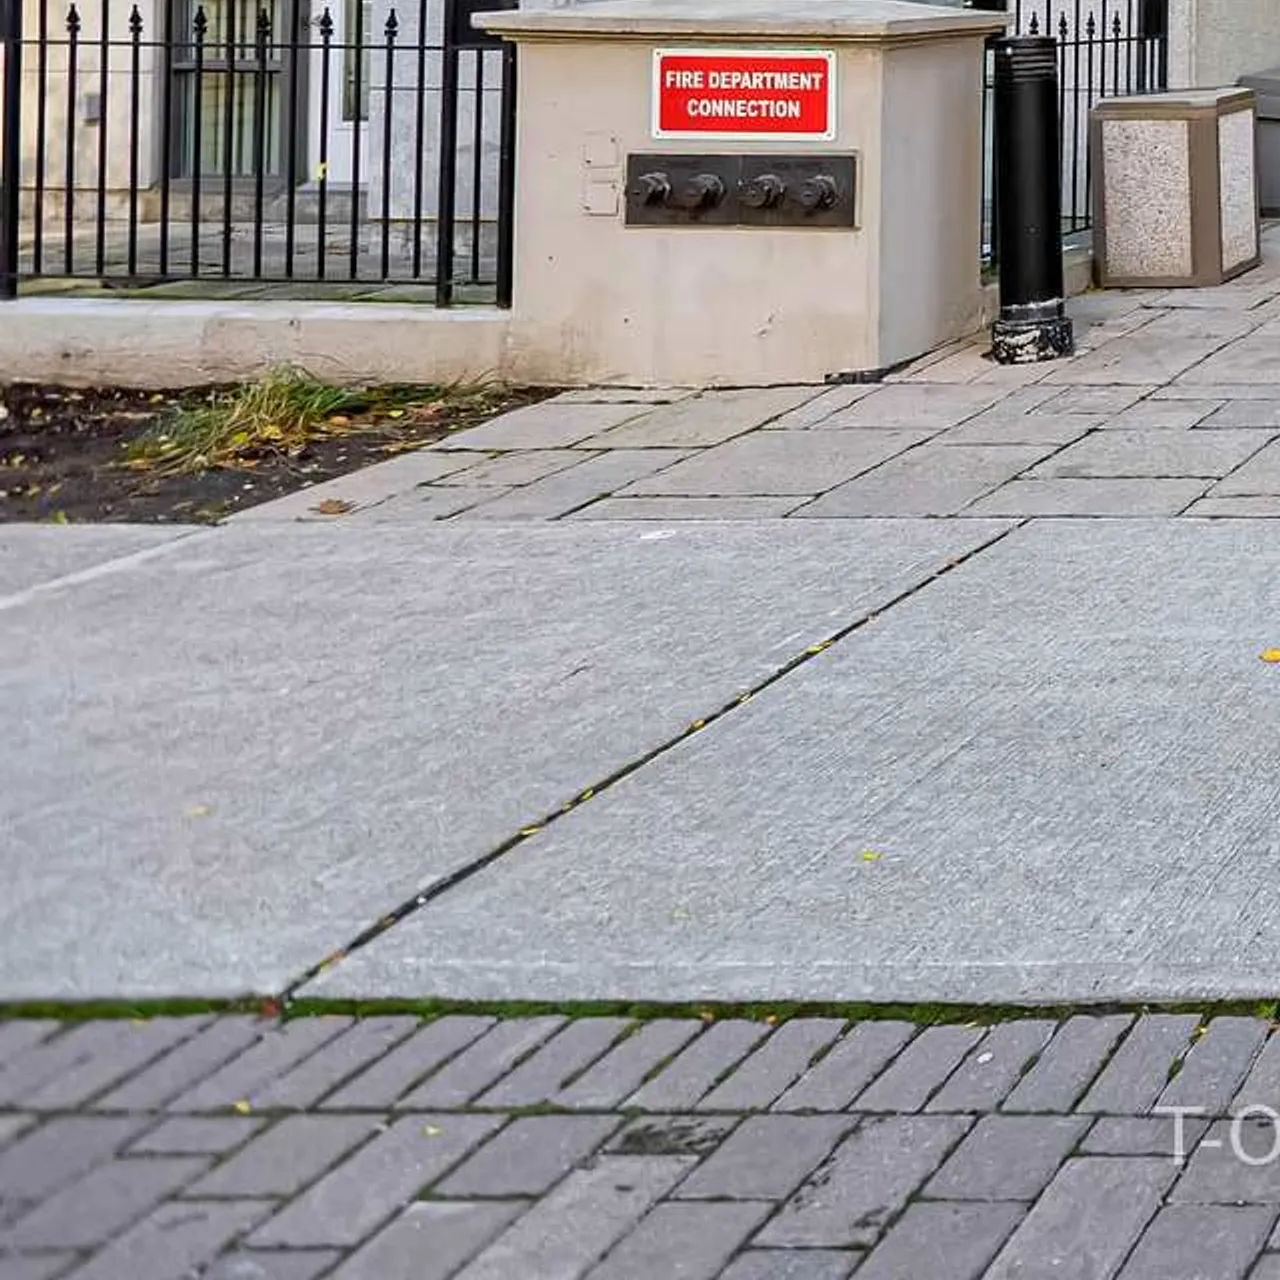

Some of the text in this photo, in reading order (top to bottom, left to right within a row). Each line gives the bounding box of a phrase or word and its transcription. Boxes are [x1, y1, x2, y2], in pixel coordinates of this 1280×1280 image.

[666, 71, 823, 90] FIRE DEPARTMENT
[687, 99, 800, 117] CONNECTION
